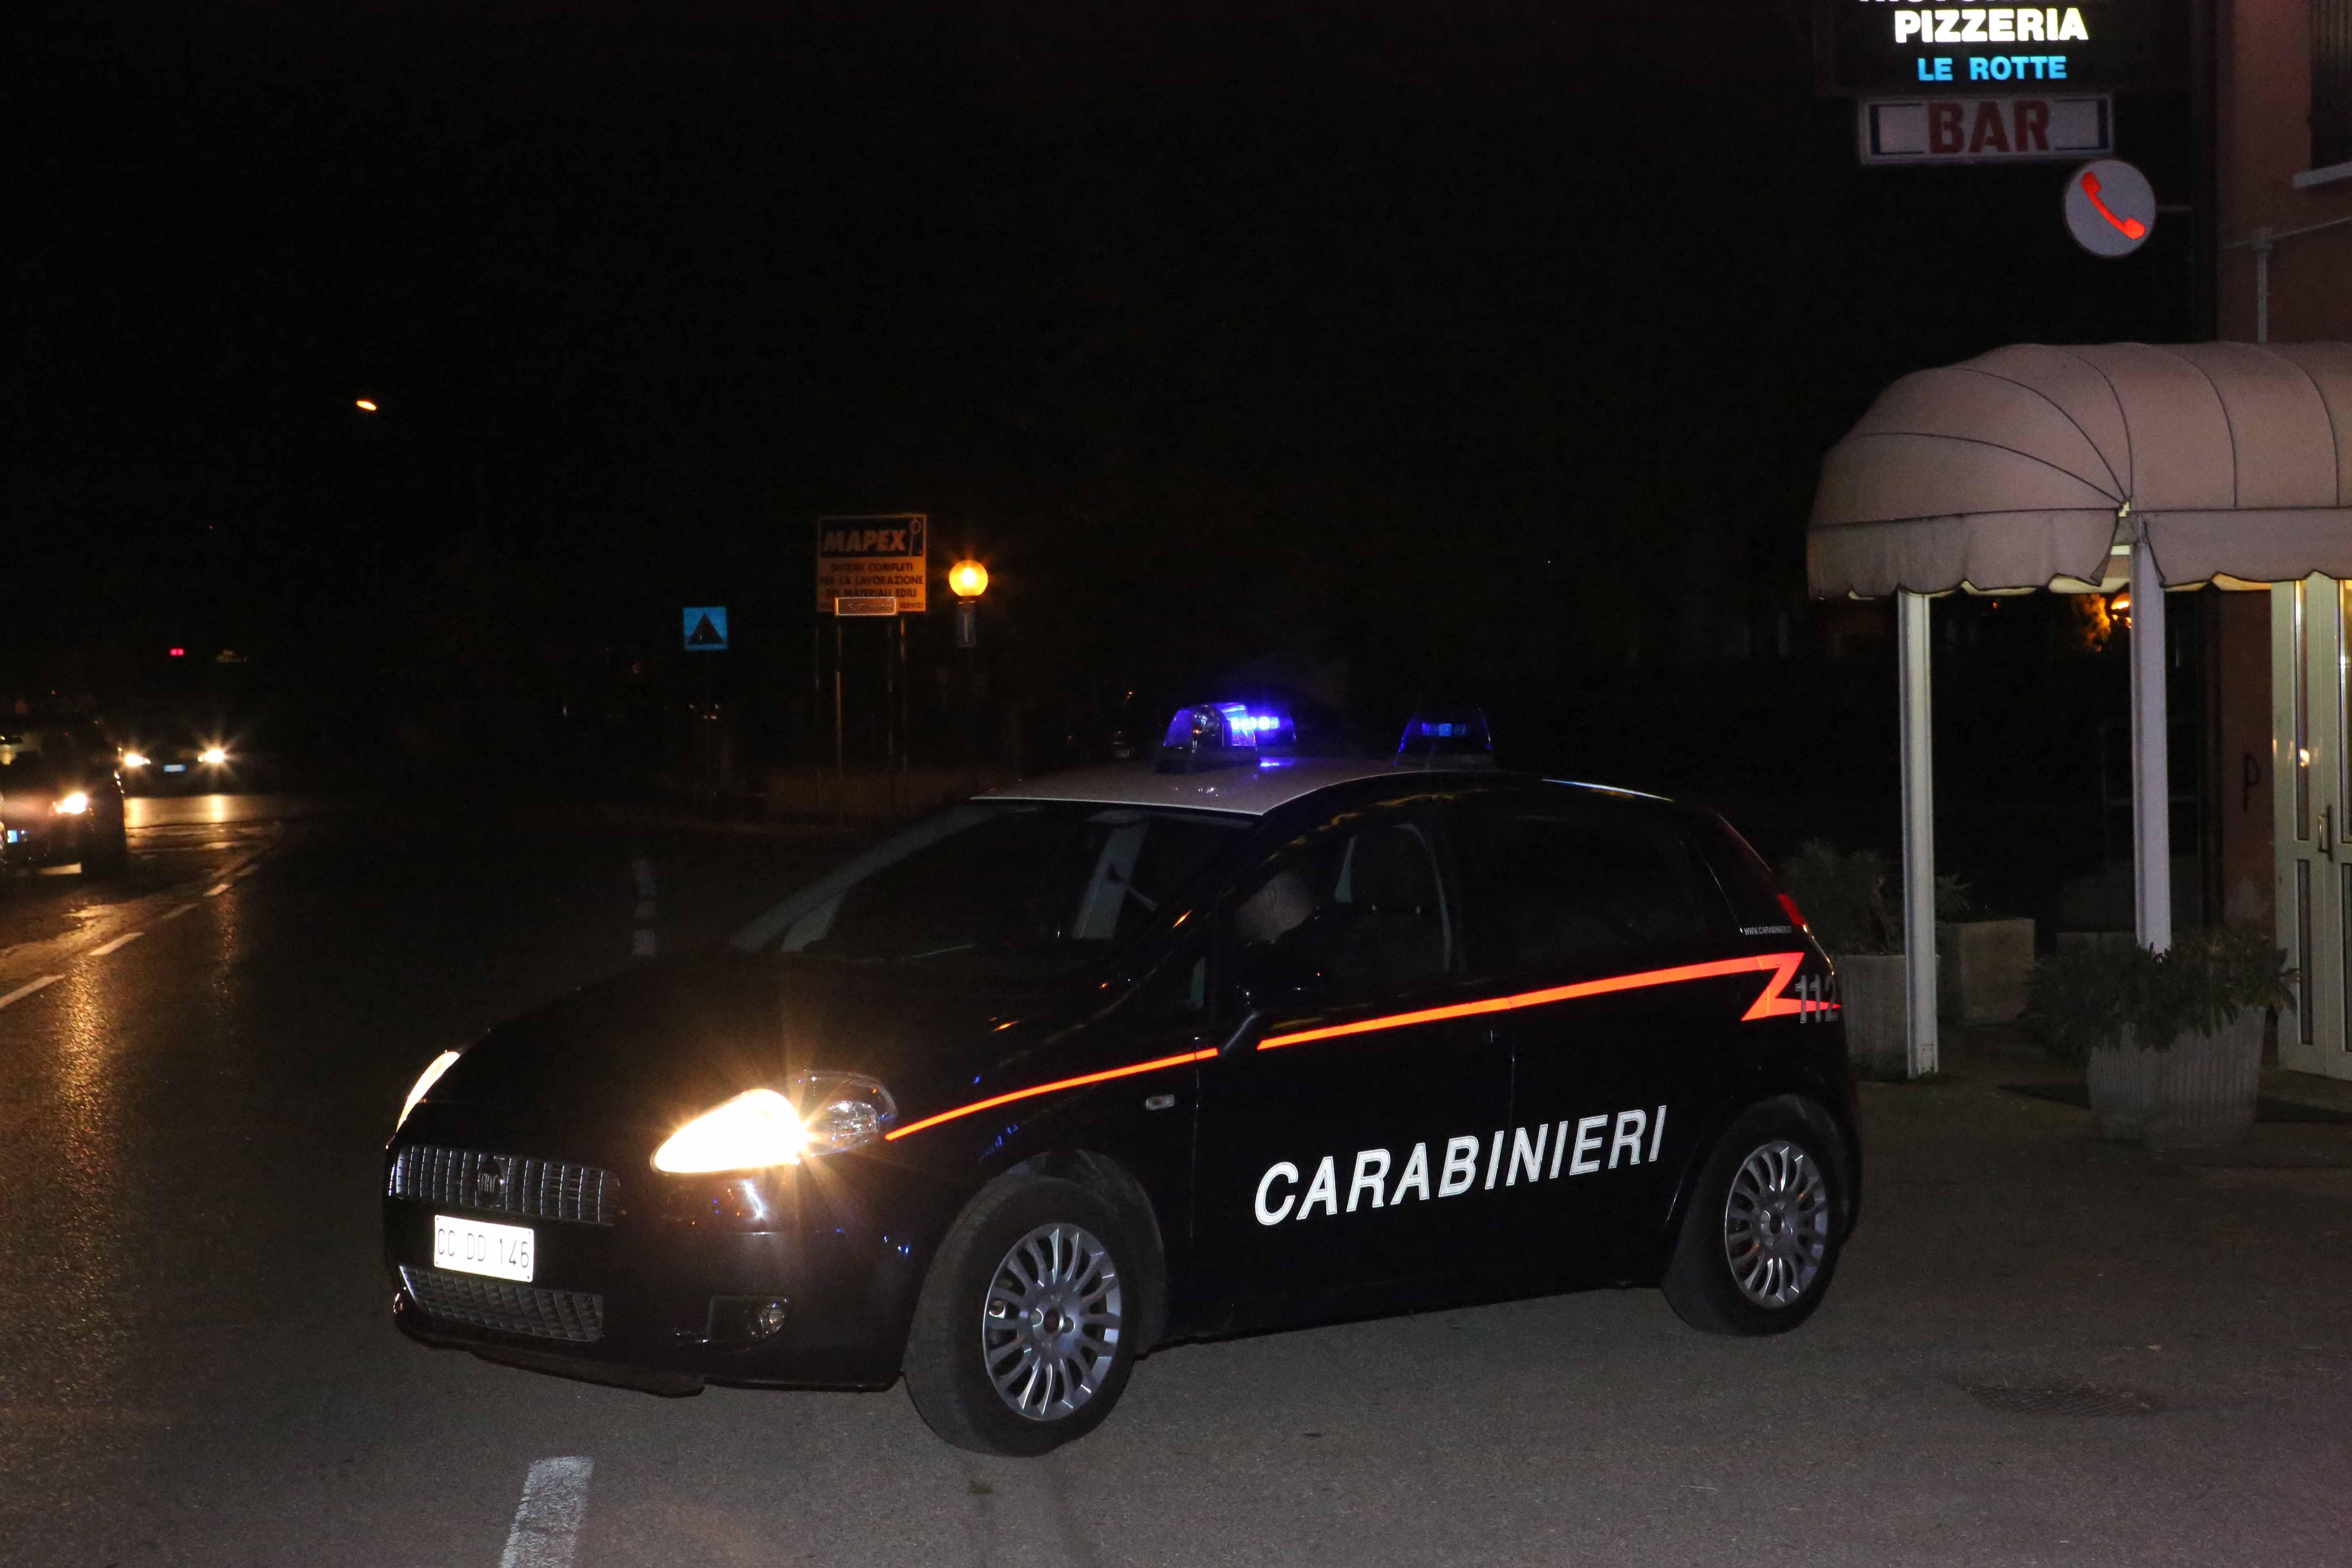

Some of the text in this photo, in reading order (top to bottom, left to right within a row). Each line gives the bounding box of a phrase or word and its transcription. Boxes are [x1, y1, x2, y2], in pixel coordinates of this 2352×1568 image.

[1895, 8, 2089, 43] PIZZERIA
[1918, 56, 2067, 81] LE ROTTE
[1928, 100, 2050, 154] BAR
[823, 530, 906, 551] MAPEX
[855, 575, 924, 585] LAVORAZIONE
[869, 563, 913, 572] COMPLETI
[1795, 974, 1839, 1024] 112
[1254, 1105, 1667, 1225] CARABINIERI
[438, 1228, 529, 1268] CC DD 146
